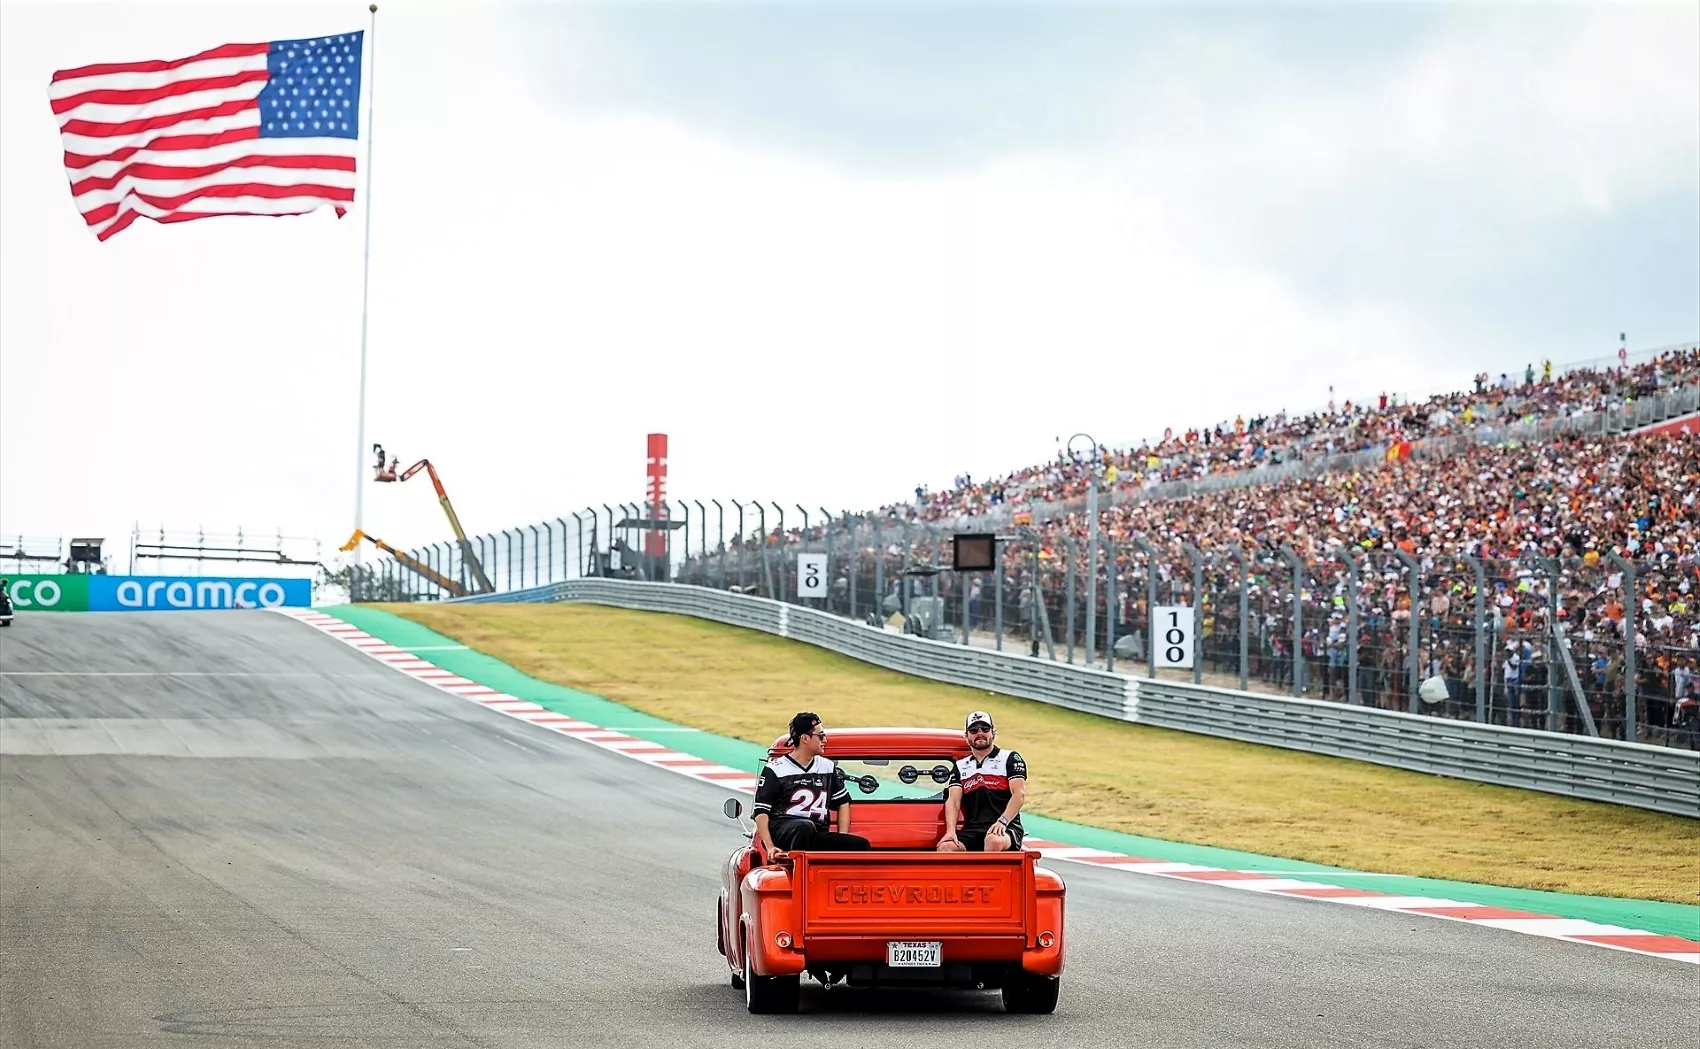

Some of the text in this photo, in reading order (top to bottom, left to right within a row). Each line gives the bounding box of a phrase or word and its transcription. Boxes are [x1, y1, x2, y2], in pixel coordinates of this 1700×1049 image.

[805, 563, 819, 588] 50
[116, 580, 286, 608] aramco
[1165, 611, 1185, 663] 100
[785, 788, 828, 820] 24
[834, 885, 995, 904] CHEVROLET
[894, 950, 936, 962] B20452V
